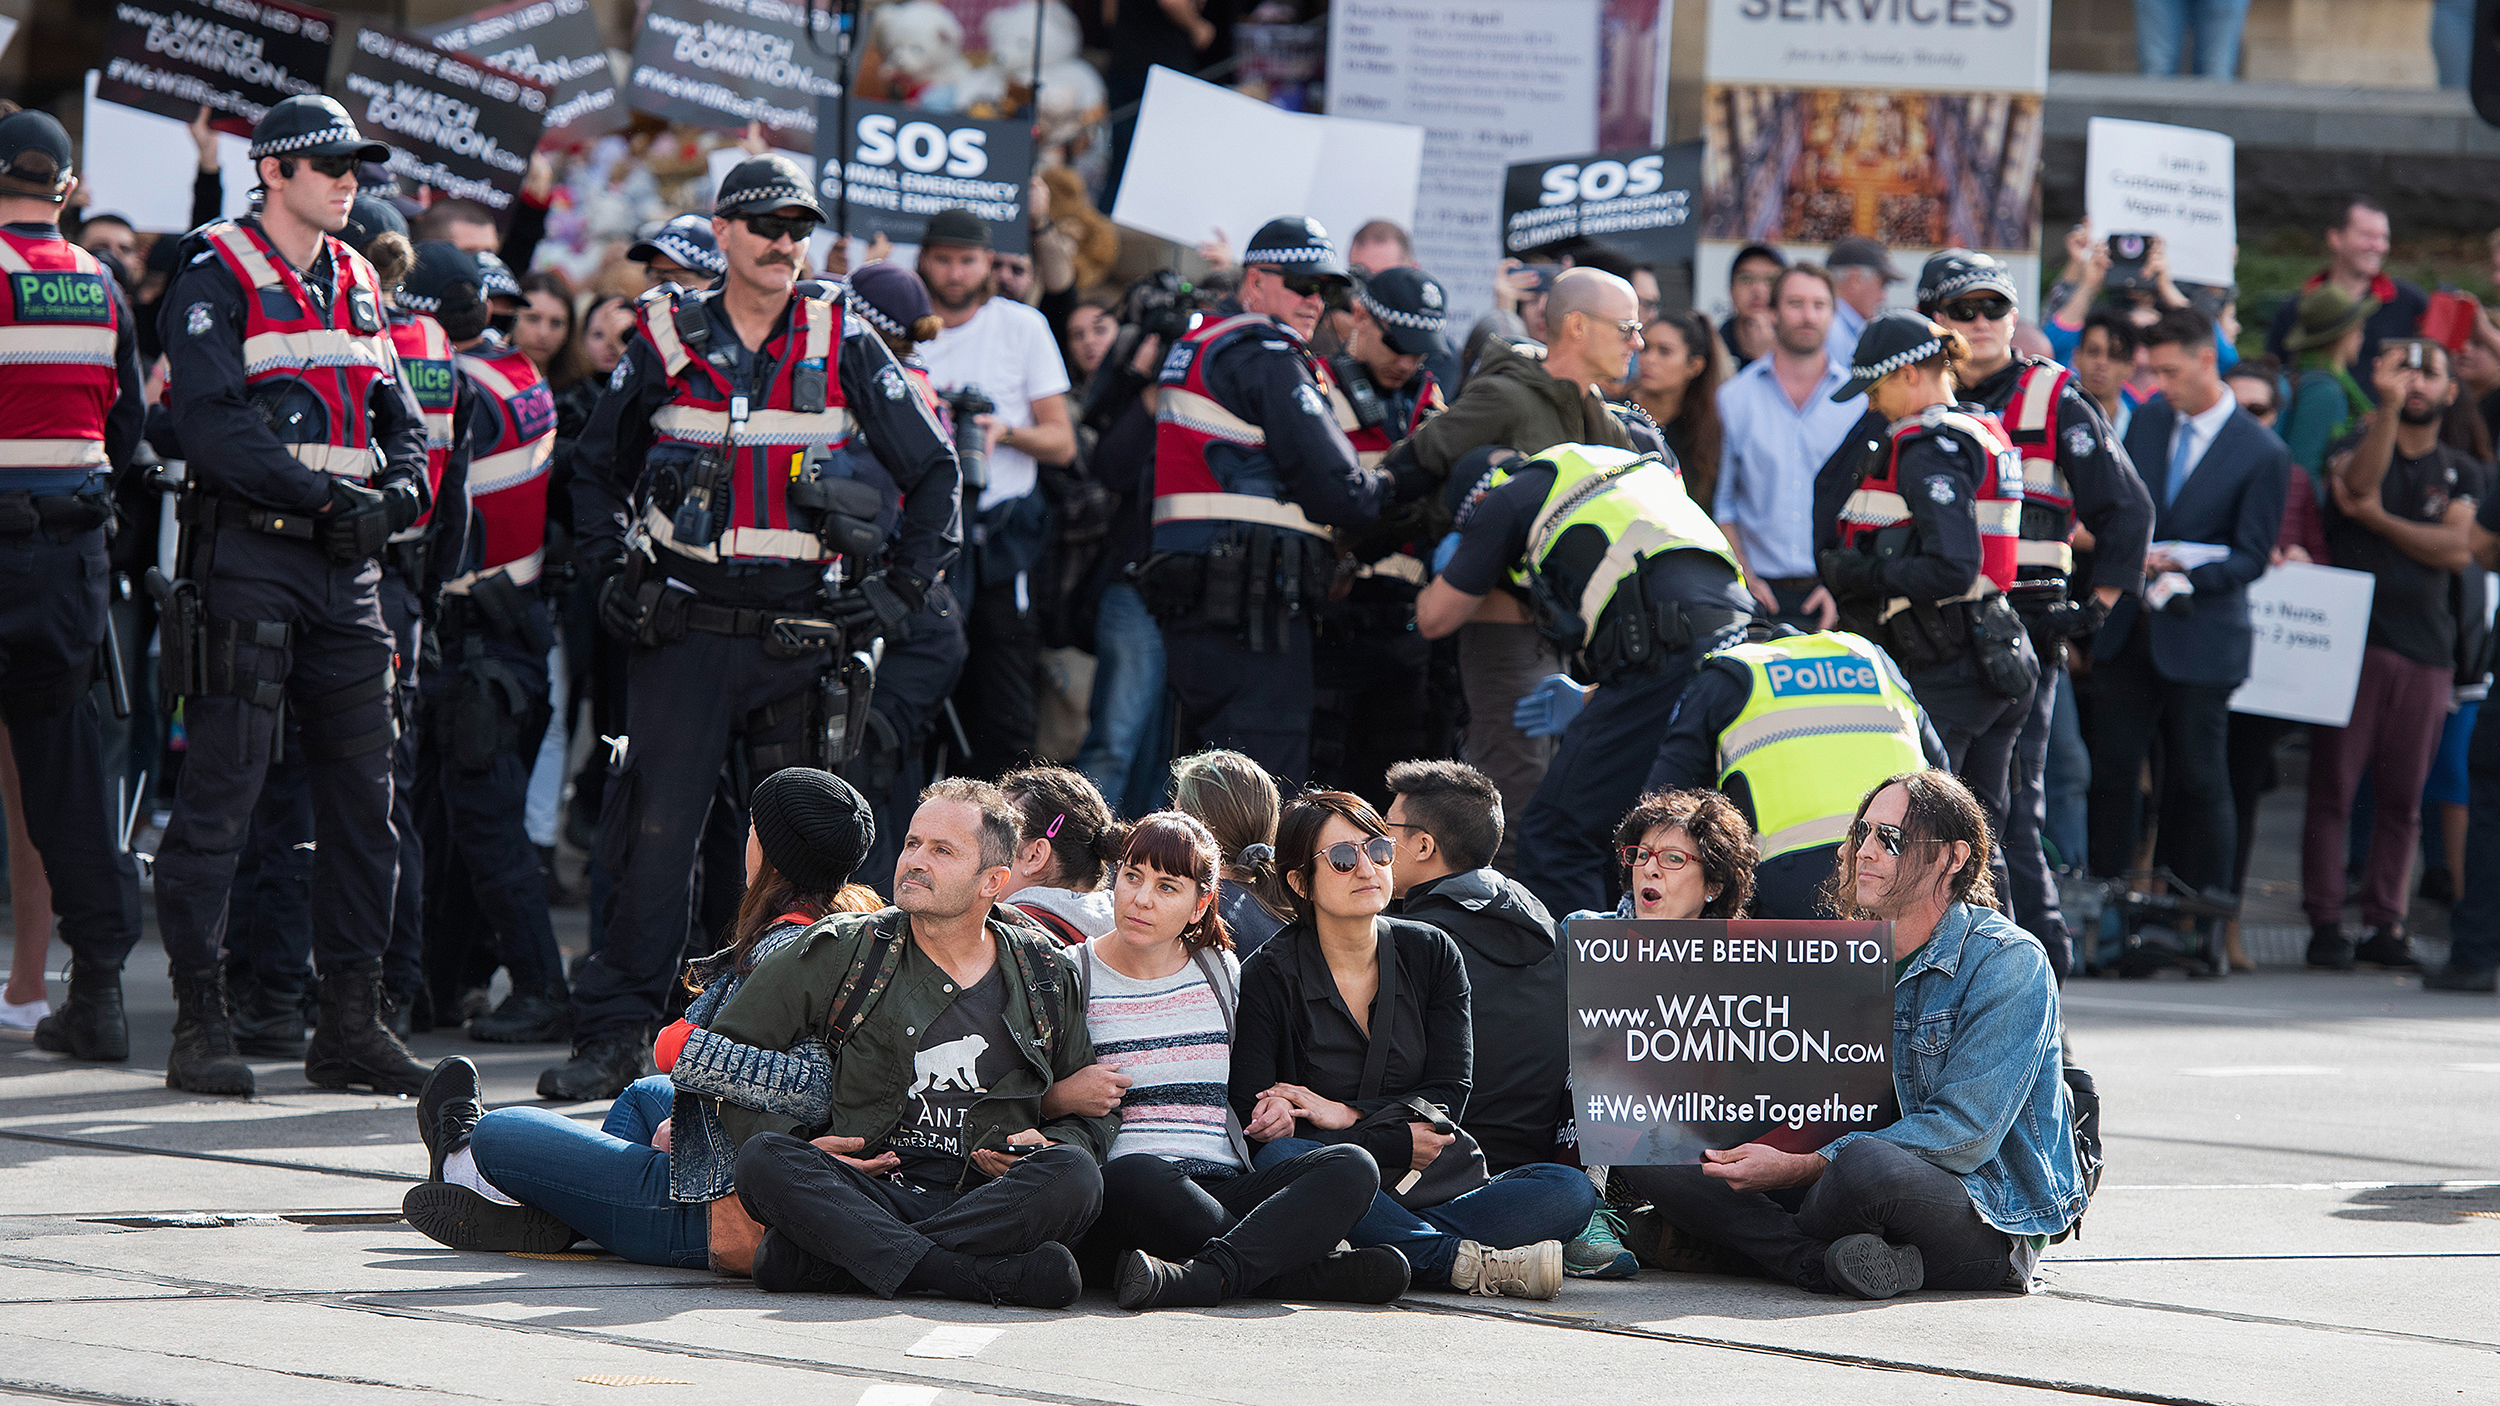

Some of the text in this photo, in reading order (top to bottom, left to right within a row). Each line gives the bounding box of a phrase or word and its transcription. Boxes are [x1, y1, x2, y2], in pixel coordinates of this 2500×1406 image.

[358, 27, 395, 60] YOU
[391, 41, 441, 76] HAVE
[436, 57, 485, 91] BEEN
[480, 73, 520, 103] LIED
[856, 114, 988, 178] SOS
[900, 171, 1020, 202] EMERGENCY
[1538, 155, 1664, 206] SOS
[1507, 189, 1691, 232] ANIMAL EMERGENCY
[1507, 216, 1580, 252] CLIMATE
[1579, 206, 1690, 236] EMERGENCY
[20, 275, 104, 304] Police
[1768, 660, 1877, 692] Police
[1574, 938, 1889, 964] YOU HAVE BEEN LIED TO.
[1578, 994, 1790, 1029] www.WATCH
[1626, 1027, 1886, 1064] DOMINION.COM
[1587, 1092, 1879, 1131] #WeWillRiseTogether
